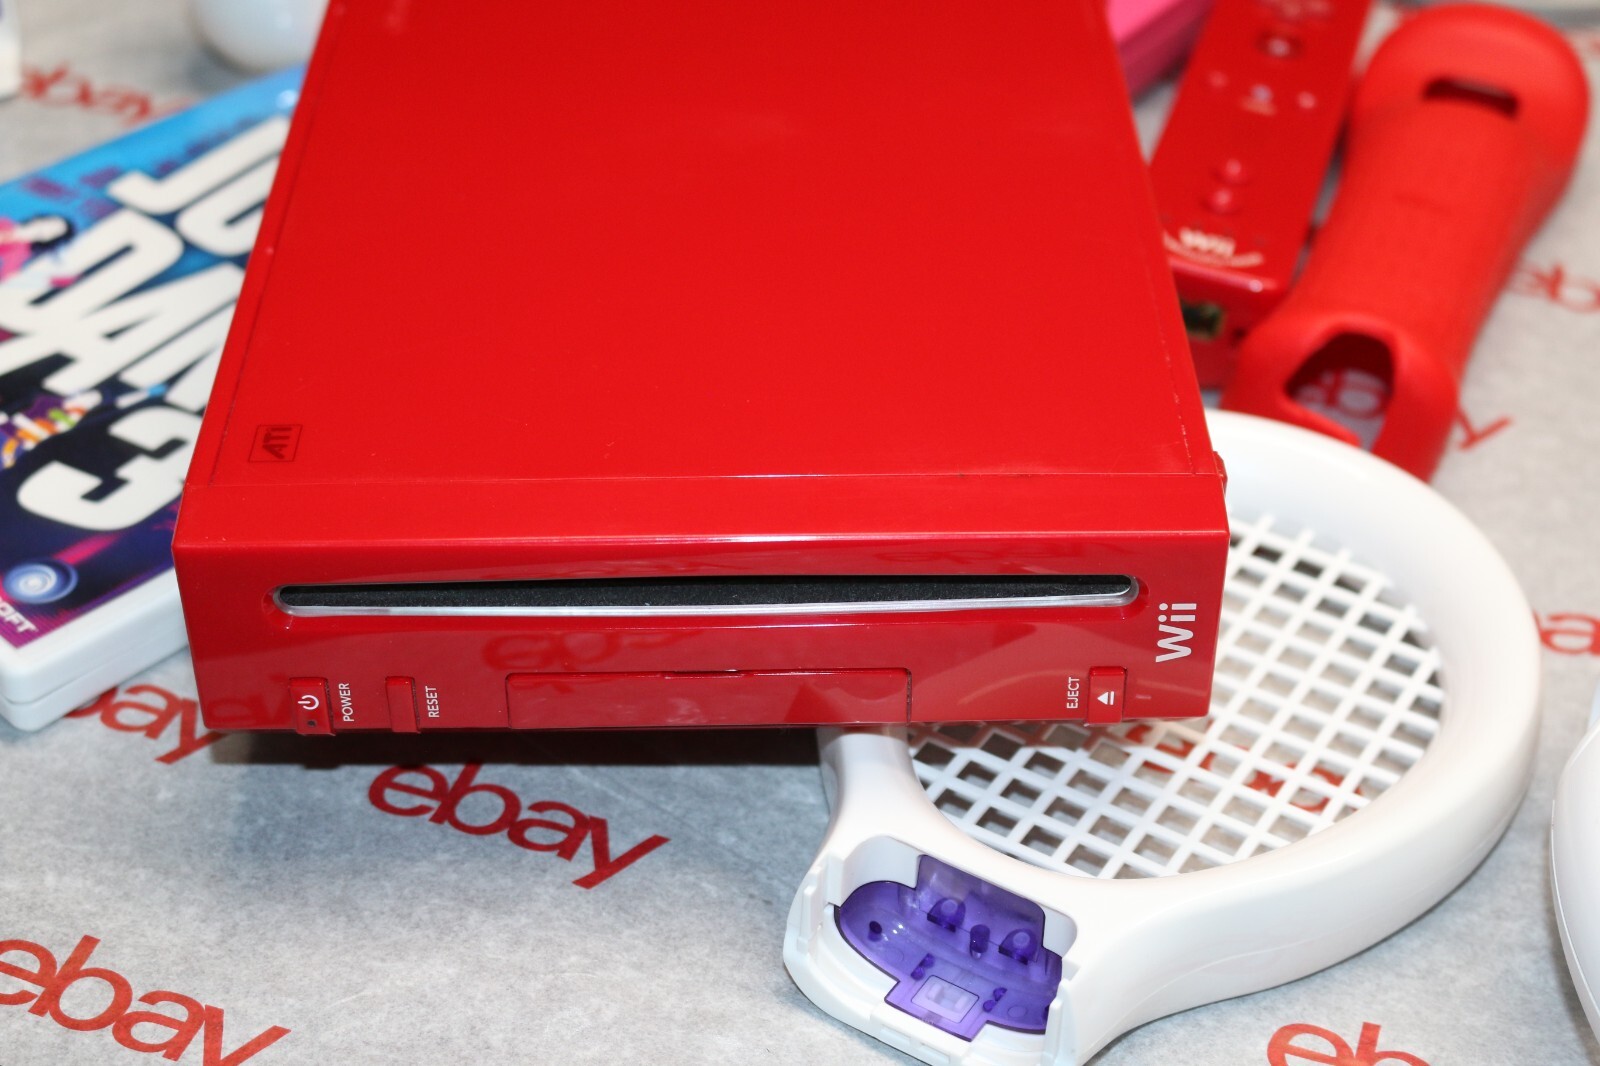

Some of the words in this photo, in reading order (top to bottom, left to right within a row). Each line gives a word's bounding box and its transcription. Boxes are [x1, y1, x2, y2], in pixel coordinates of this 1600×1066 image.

[1155, 603, 1197, 662] Wii
[338, 683, 355, 722] POWER
[425, 685, 440, 718] RESET
[1066, 677, 1080, 709] EJECT
[368, 760, 672, 890] ebay
[0, 934, 292, 1066] ebay
